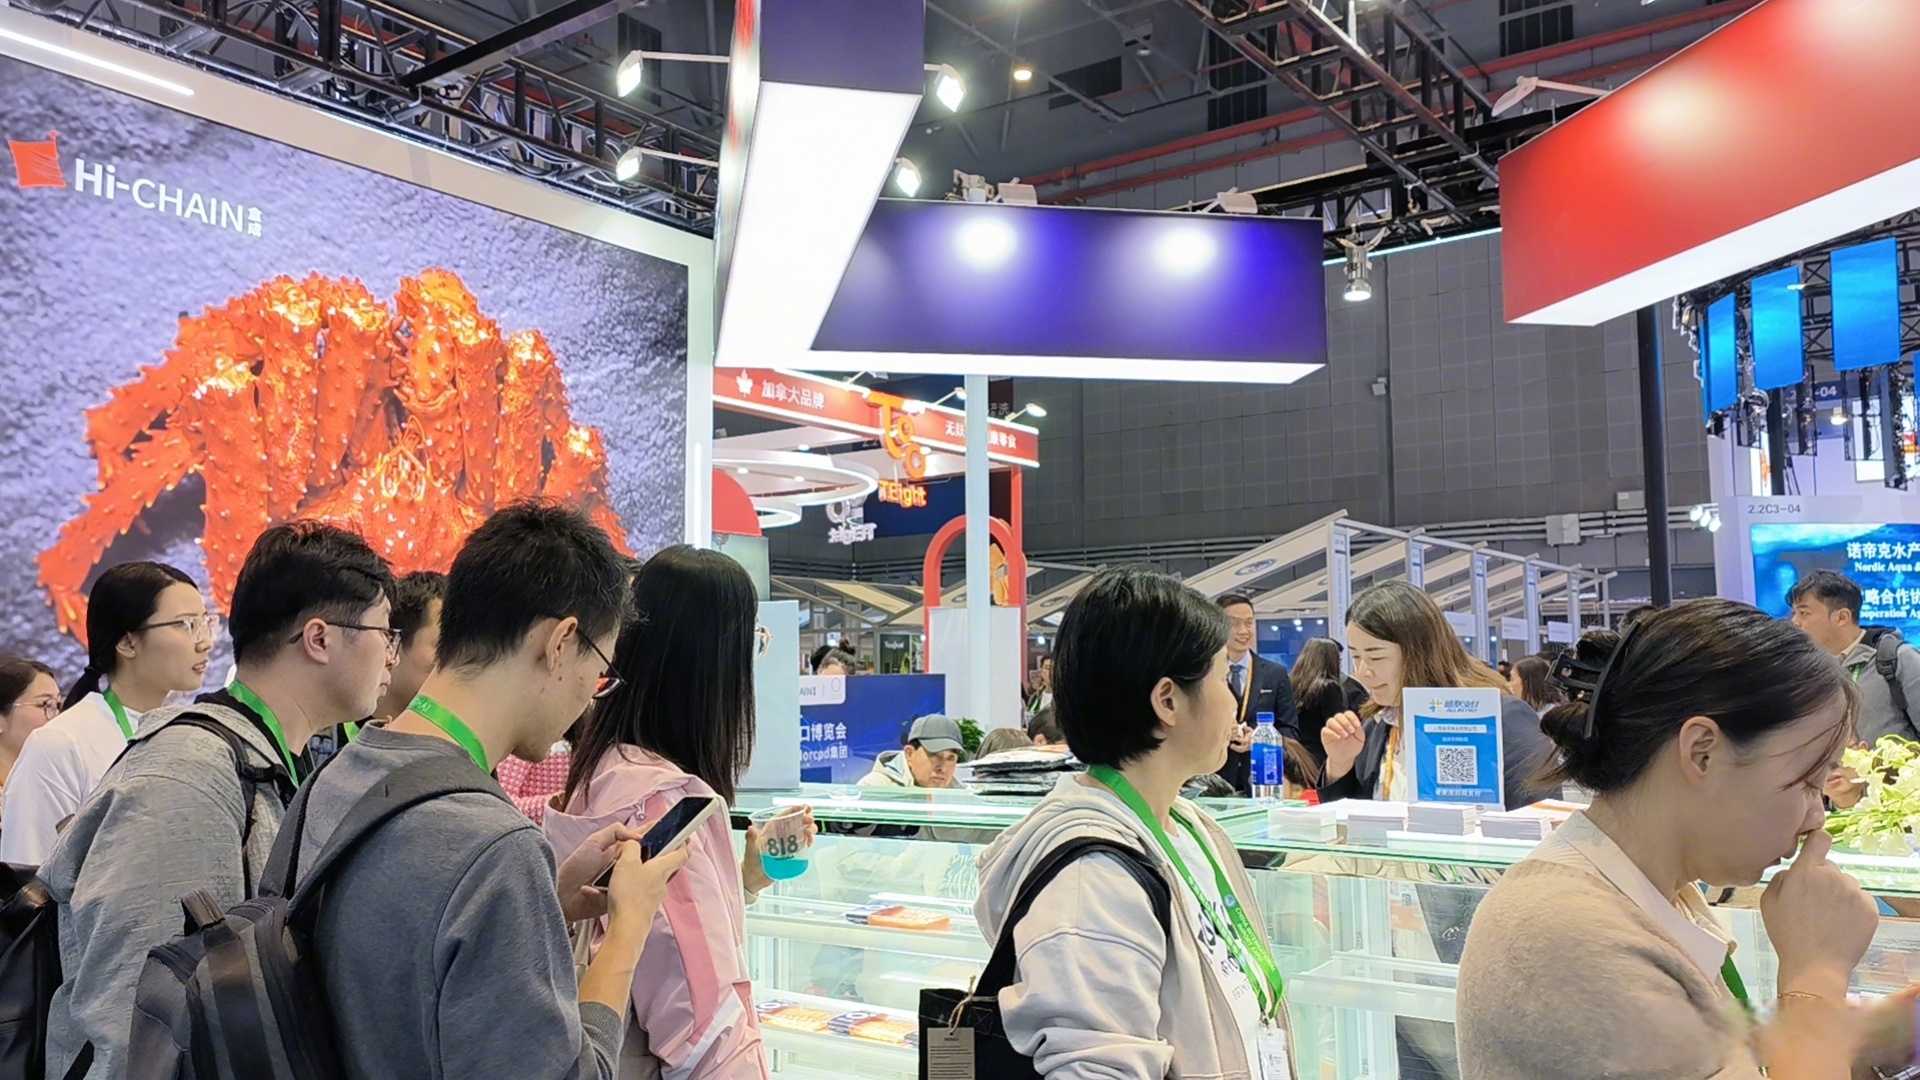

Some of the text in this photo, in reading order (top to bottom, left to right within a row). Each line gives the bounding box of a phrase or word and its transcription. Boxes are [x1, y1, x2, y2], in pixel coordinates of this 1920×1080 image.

[75, 158, 243, 233] Hi-CHAIN
[761, 379, 825, 410] 加拿大品牌
[1748, 504, 1801, 514] 2.2C3-04
[1846, 541, 1920, 560] 诺帝克水产
[1855, 562, 1886, 572] Nordic
[1887, 562, 1912, 575] Aqua
[1861, 588, 1920, 605] 略合作协
[1859, 608, 1907, 621] ooperation
[800, 722, 847, 742] 口博览会
[800, 745, 848, 762] orcpd集团
[767, 834, 798, 856] 818
